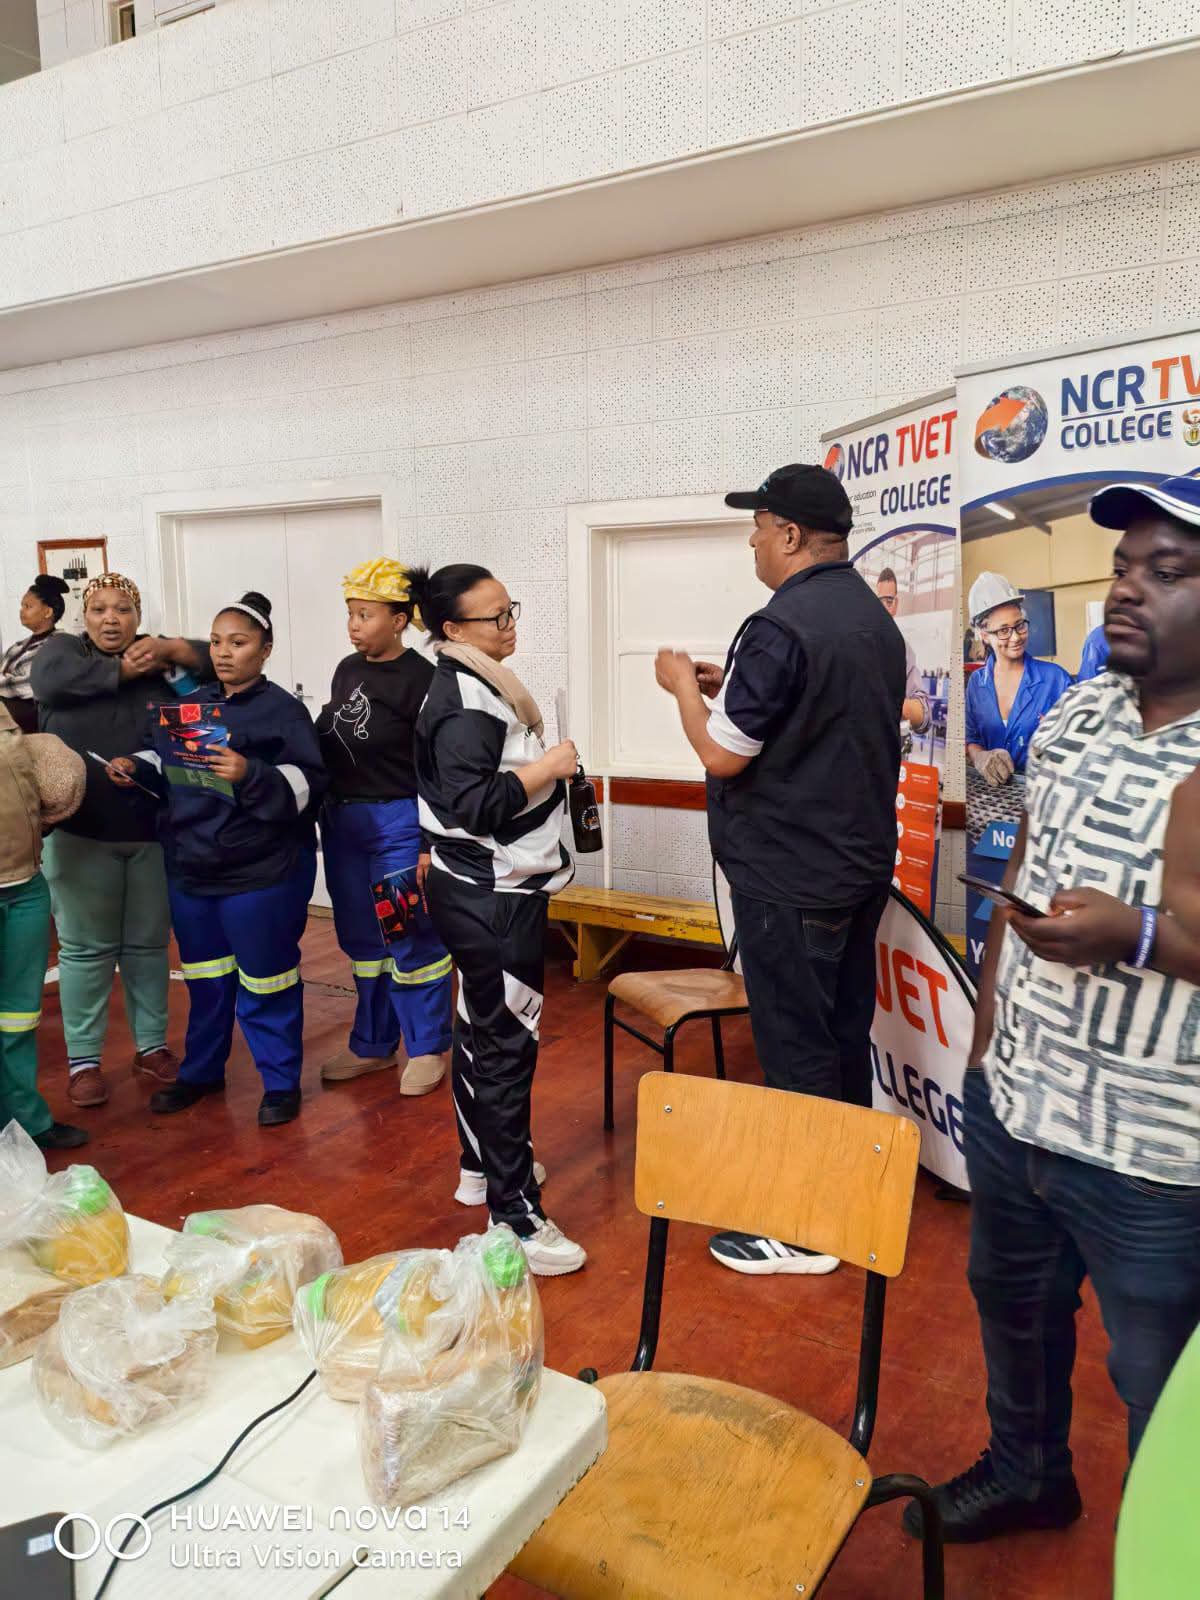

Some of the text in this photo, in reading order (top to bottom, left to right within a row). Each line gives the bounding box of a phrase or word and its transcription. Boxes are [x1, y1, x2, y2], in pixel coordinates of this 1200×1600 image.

[1061, 365, 1145, 416] NCR
[847, 410, 957, 480] NCR TVET
[1060, 411, 1172, 450] COLLEGE
[880, 474, 951, 516] COLLEGE
[970, 938, 985, 965] Y
